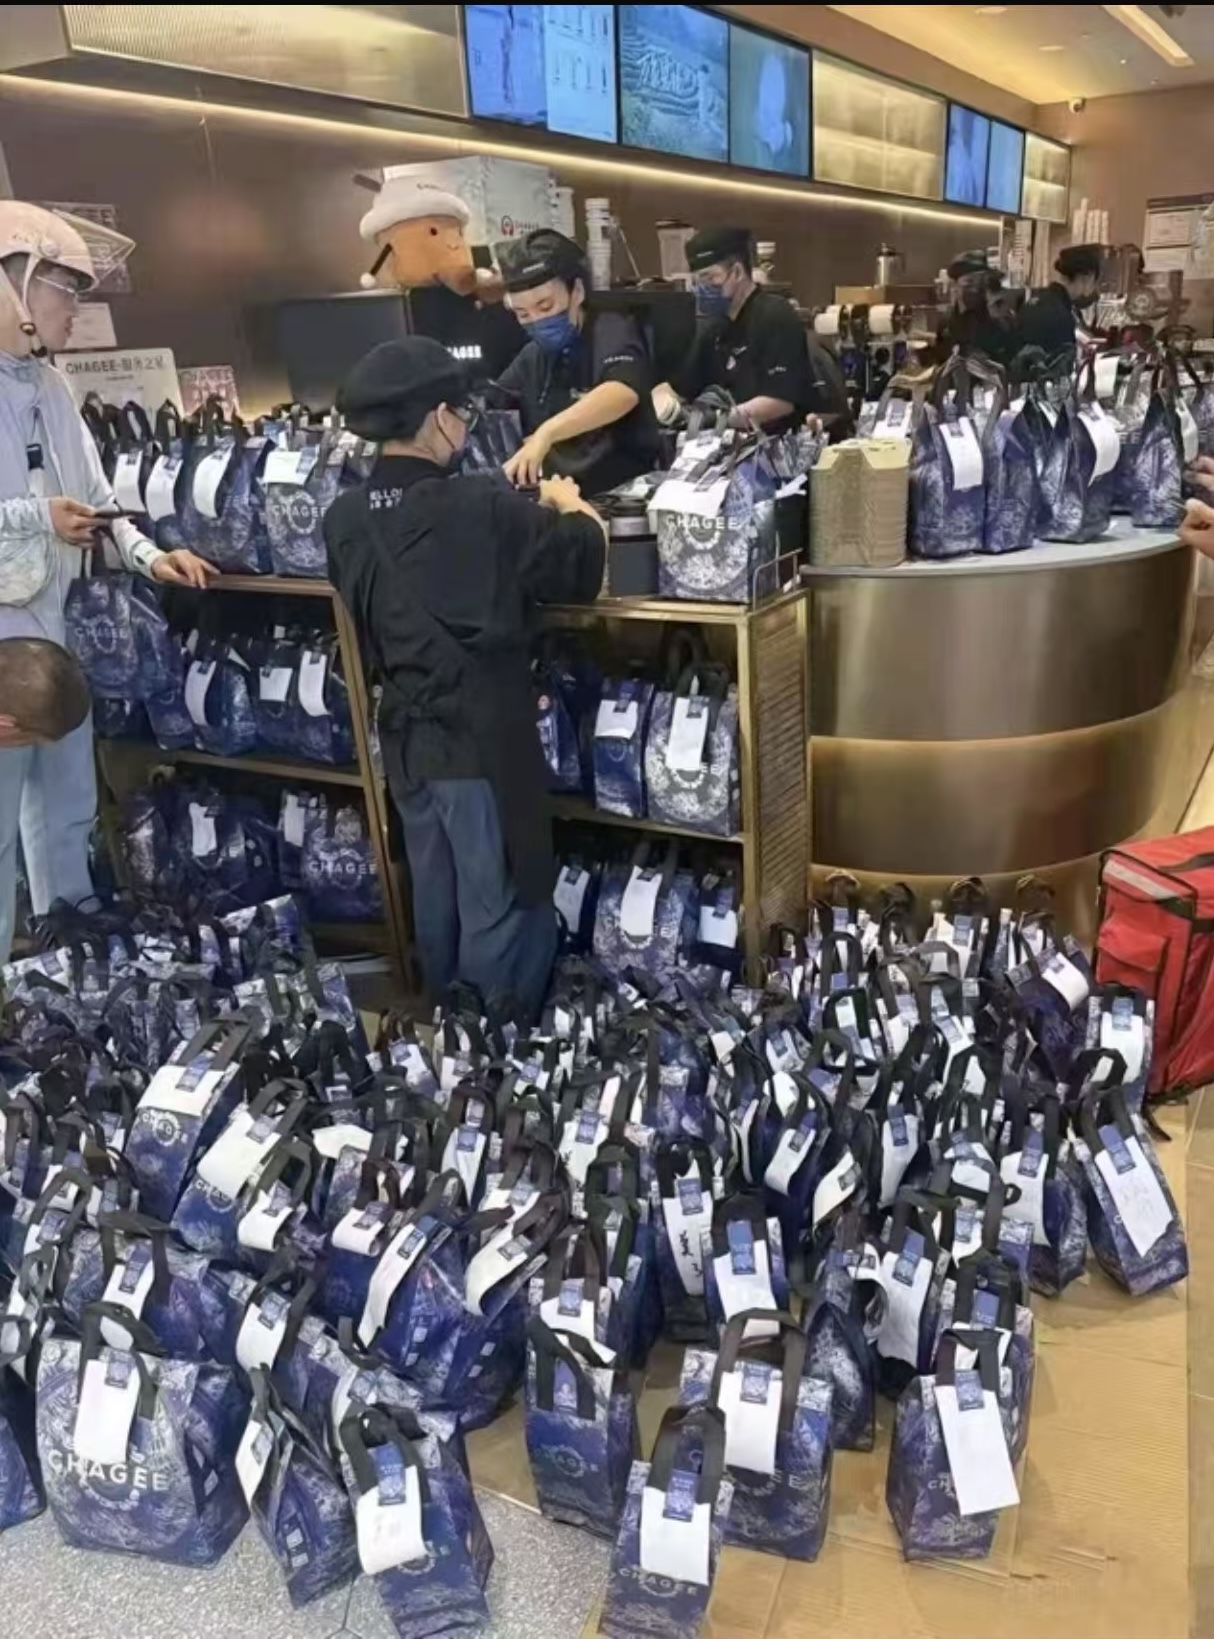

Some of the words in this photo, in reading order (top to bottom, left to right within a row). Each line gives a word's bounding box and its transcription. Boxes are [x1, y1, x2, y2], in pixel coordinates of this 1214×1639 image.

[447, 345, 482, 359] AGEE
[666, 513, 739, 530] CHAGEE
[308, 860, 377, 875] CHAGEE
[48, 1449, 169, 1492] CHAGEE
